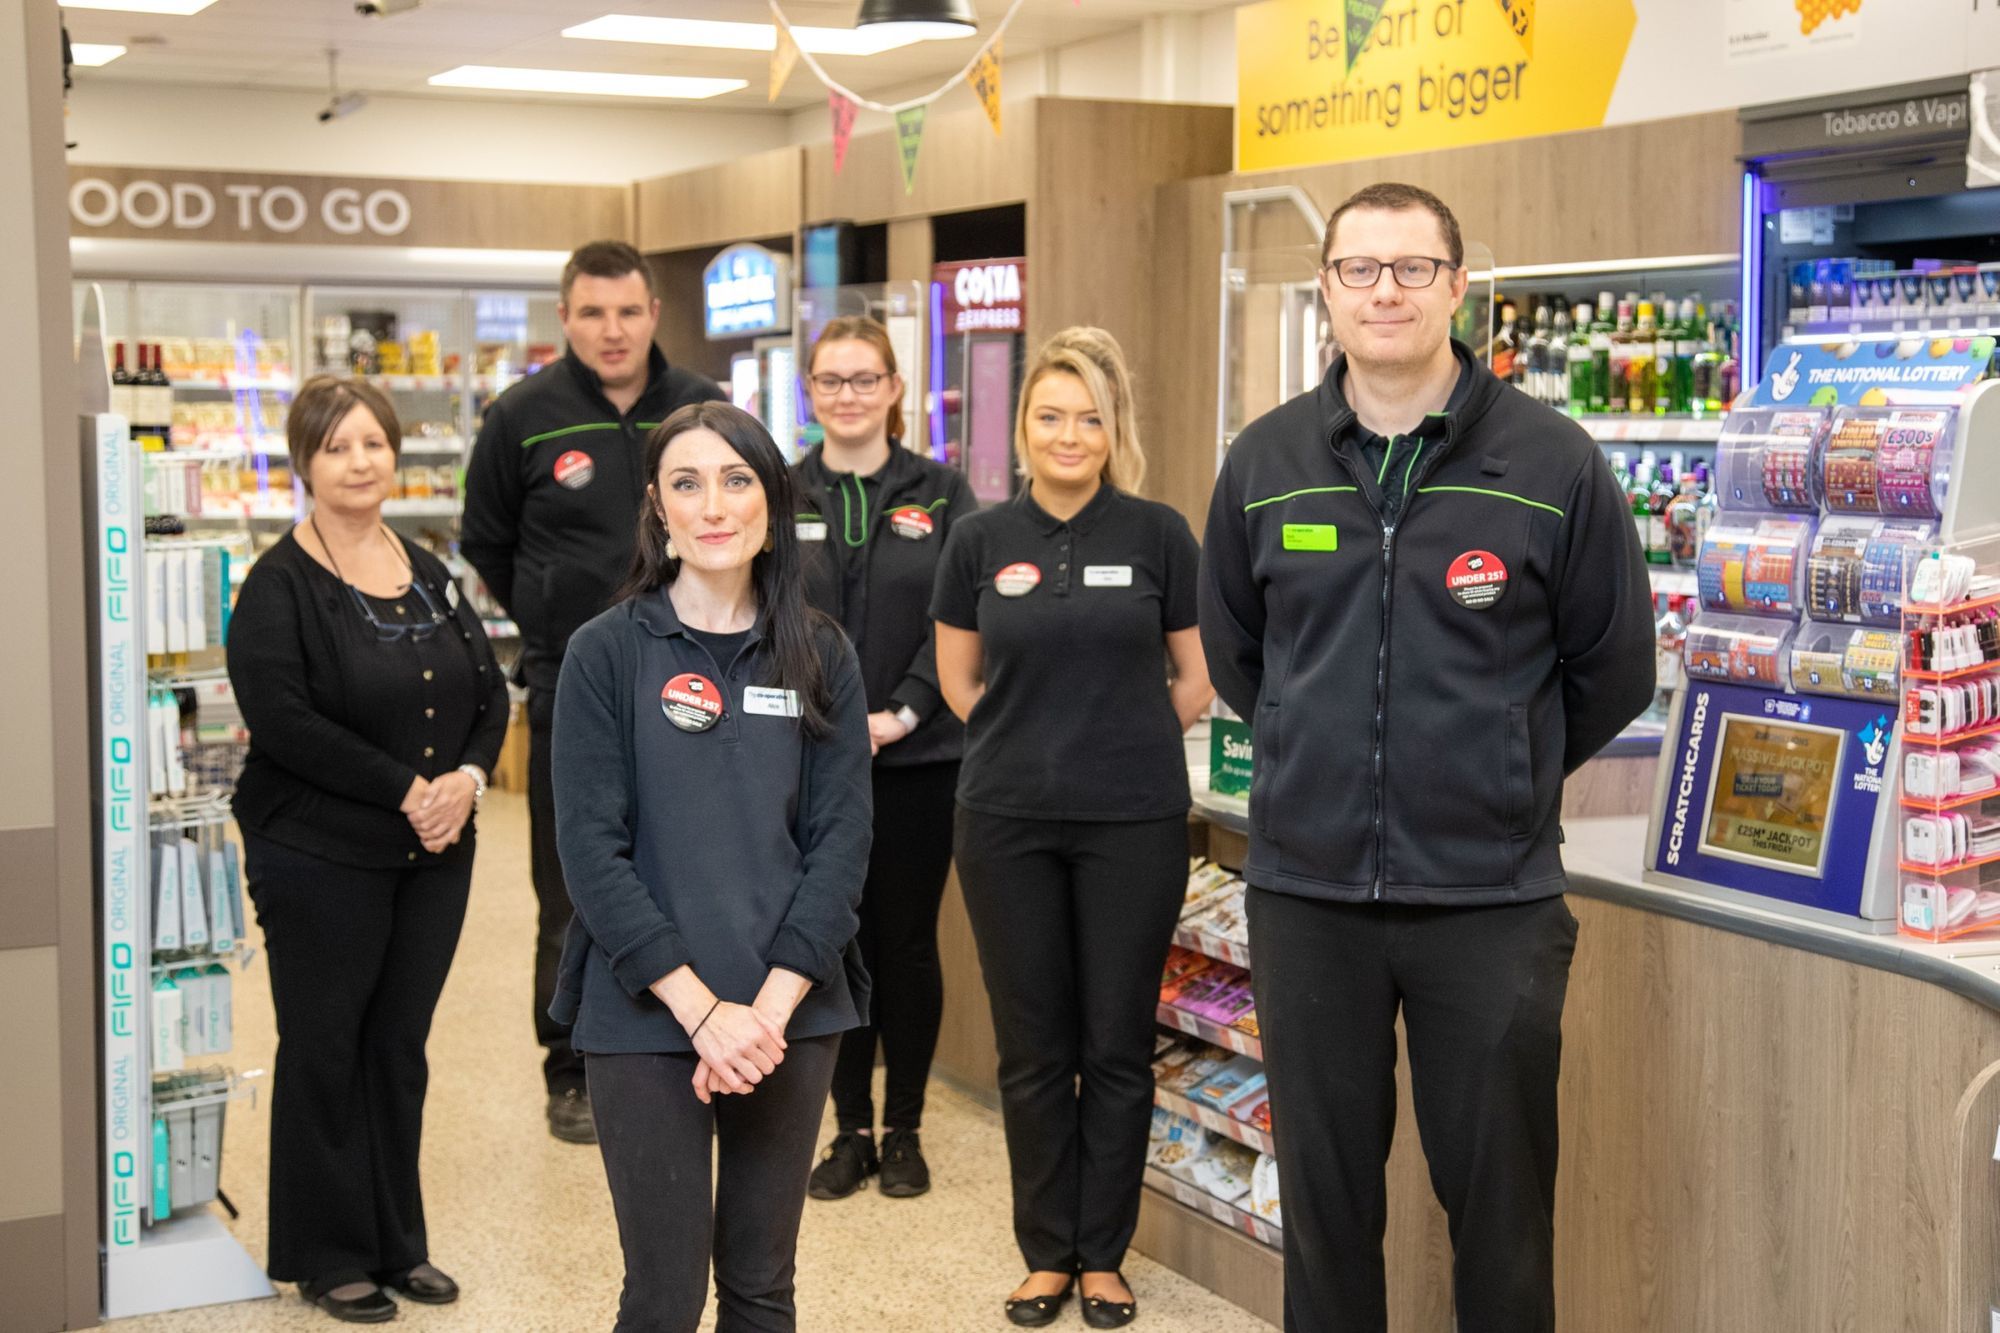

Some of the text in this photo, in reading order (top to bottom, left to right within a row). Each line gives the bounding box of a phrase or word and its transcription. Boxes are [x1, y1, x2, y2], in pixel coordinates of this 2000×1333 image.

[1308, 19, 1340, 61] Be
[1434, 0, 1466, 38] of
[1257, 60, 1528, 137] something bigger
[1823, 95, 1968, 137] Tobacco & Vapi
[225, 184, 308, 233] TO
[321, 187, 411, 236] GO
[954, 264, 1021, 308] COSTA
[955, 307, 1020, 331] EXPRESS
[1808, 365, 1971, 384] THE NATIONAL LOTTERY
[1887, 428, 1933, 446] £500s
[104, 428, 128, 623] FIFO ORIGINAL
[1451, 570, 1504, 586] UNDER 25?
[668, 689, 720, 712] UNDER 25?
[109, 640, 132, 832] FIFO ORIGINAL
[1667, 692, 1709, 866] SCRATCHCARDS
[1730, 746, 1831, 775] MASSIVE JACKPOT
[1865, 767, 1878, 776] THE
[1752, 840, 1793, 855] THIS FRIDAY
[1766, 828, 1813, 849] JACKPOT
[110, 845, 132, 1037] FIFO ORIGINAL
[112, 1055, 134, 1246] FIFO ORIGINAL
